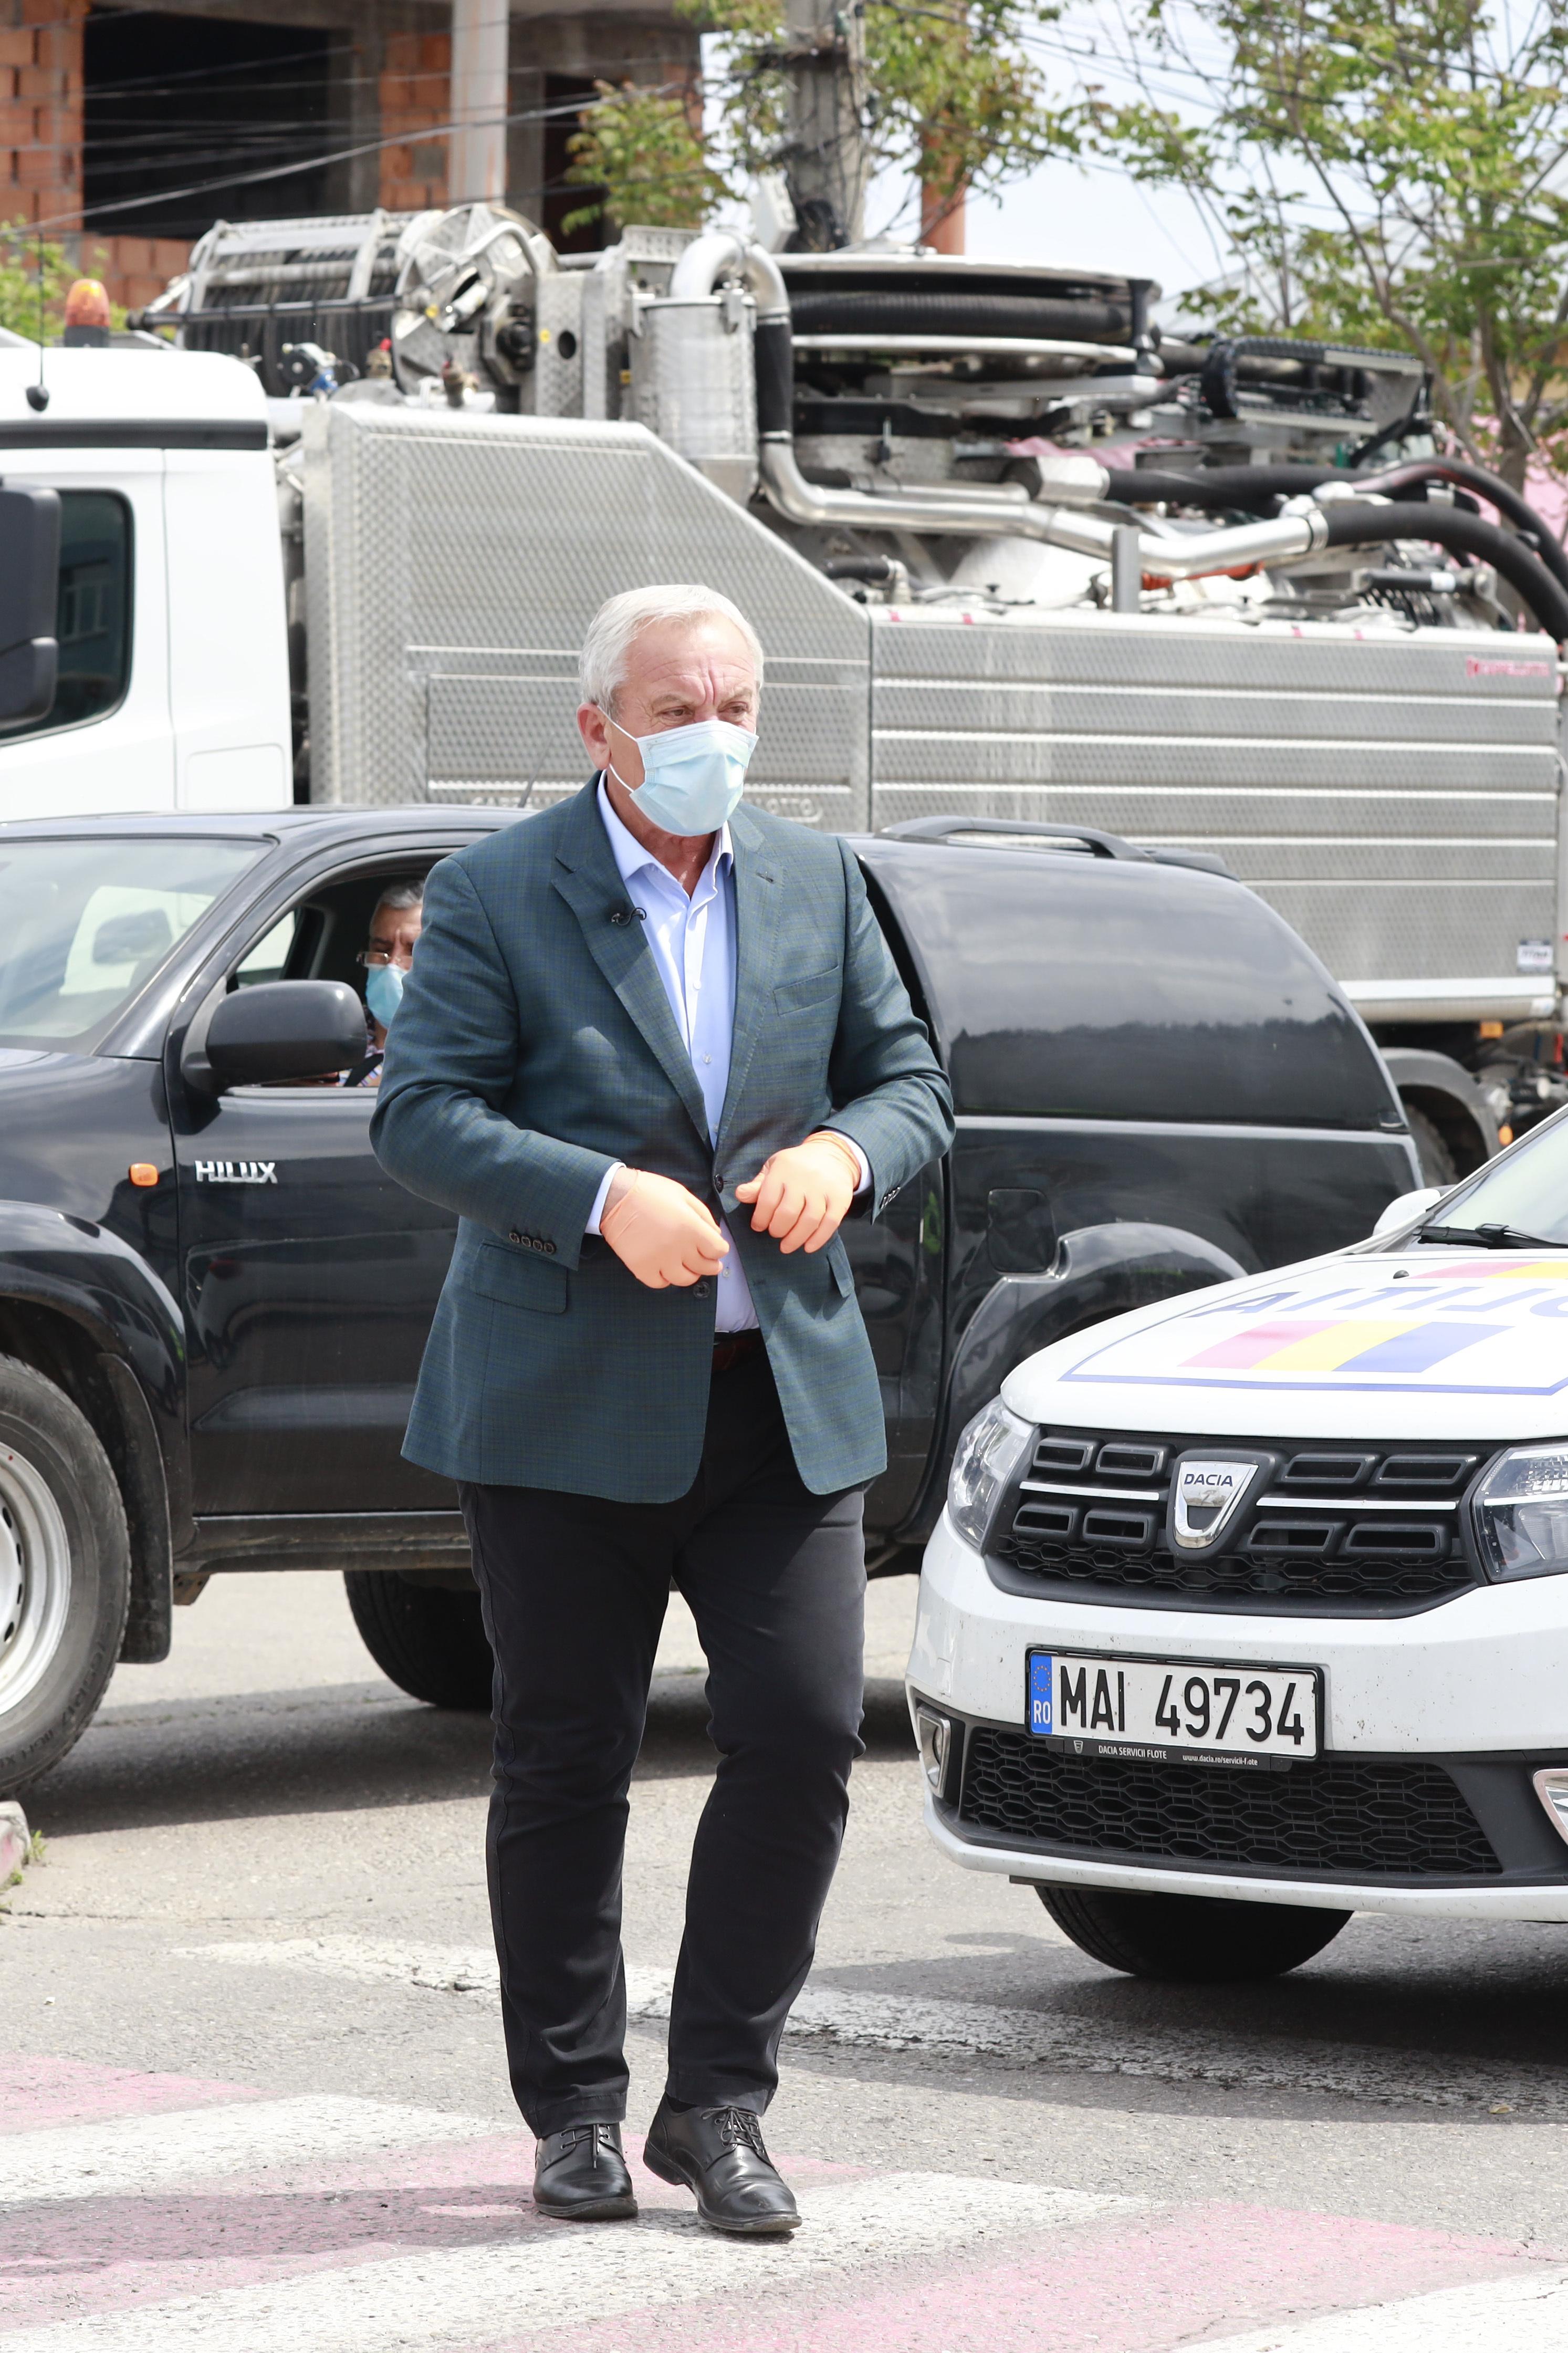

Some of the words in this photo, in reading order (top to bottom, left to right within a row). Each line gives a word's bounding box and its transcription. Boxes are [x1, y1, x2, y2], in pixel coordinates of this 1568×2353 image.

[195, 1160, 278, 1184] HILUX
[1184, 1474, 1233, 1487] DACIA
[1033, 1700, 1051, 1724] RO
[1060, 1665, 1125, 1732] MAI
[1155, 1674, 1304, 1745] 49734
[1099, 1745, 1118, 1755] DACIA
[1118, 1747, 1145, 1757] SERVICII
[1147, 1750, 1167, 1759] FLOTE
